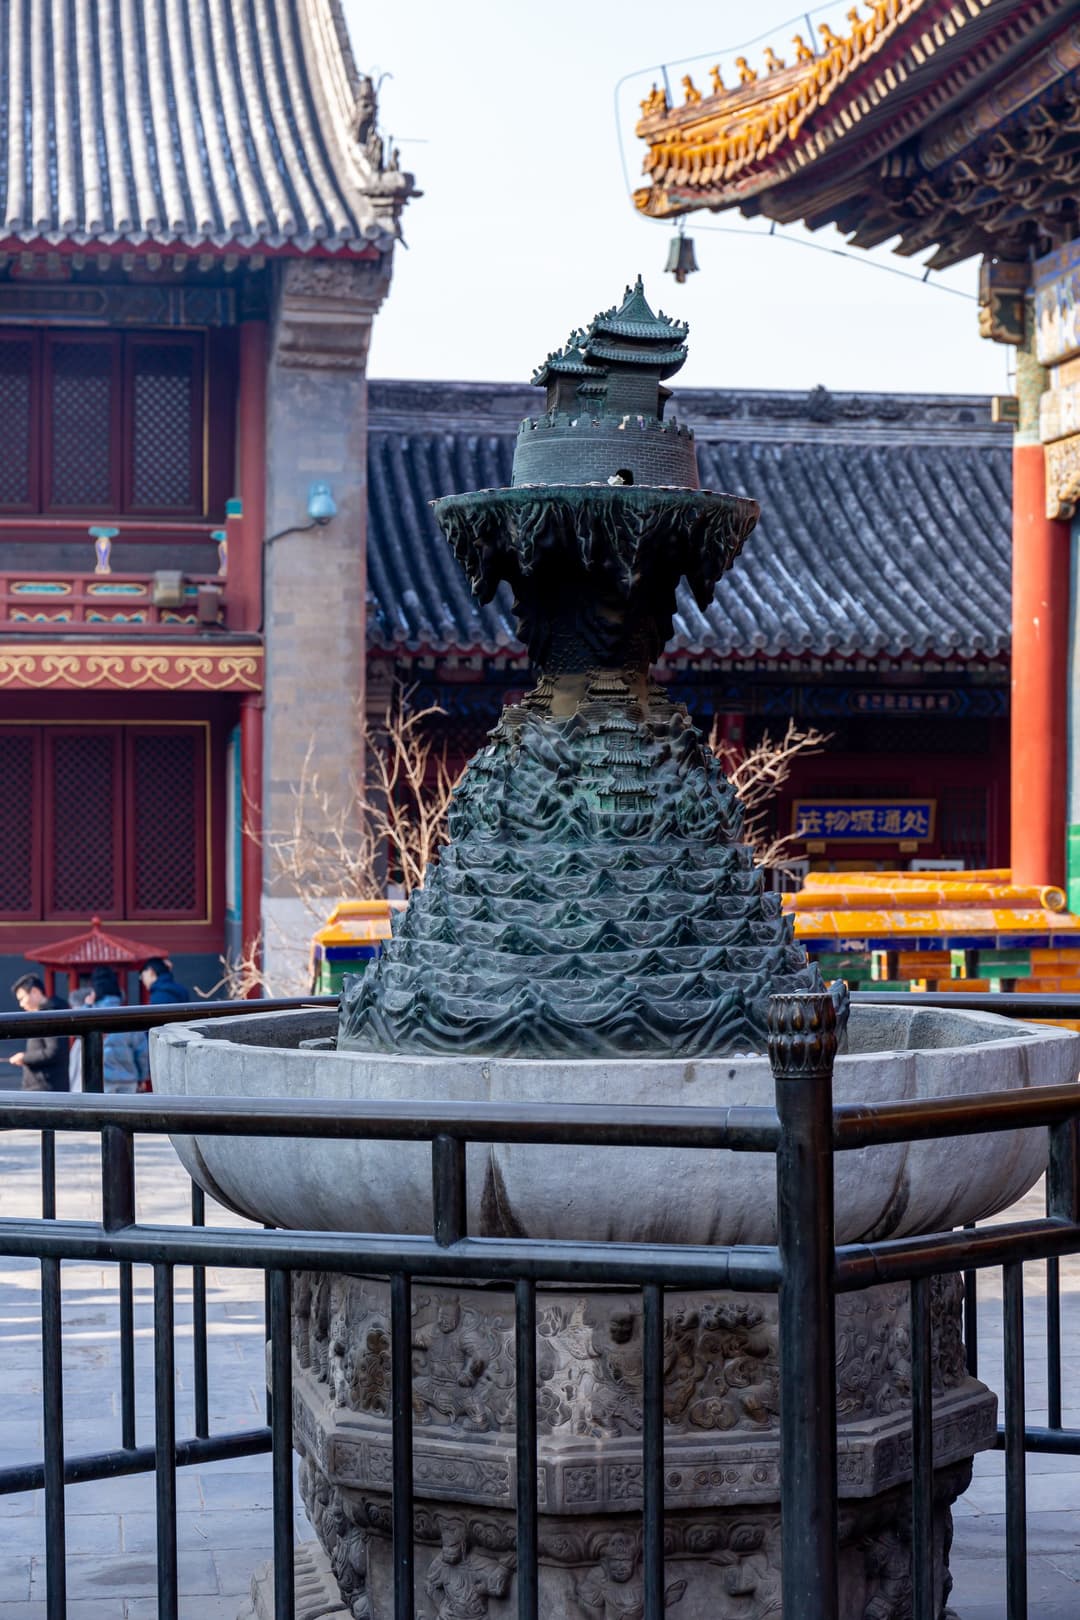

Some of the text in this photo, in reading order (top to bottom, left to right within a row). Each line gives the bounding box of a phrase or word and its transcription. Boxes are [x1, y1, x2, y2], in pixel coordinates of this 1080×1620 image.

[799, 809, 928, 834] 法物流通处
